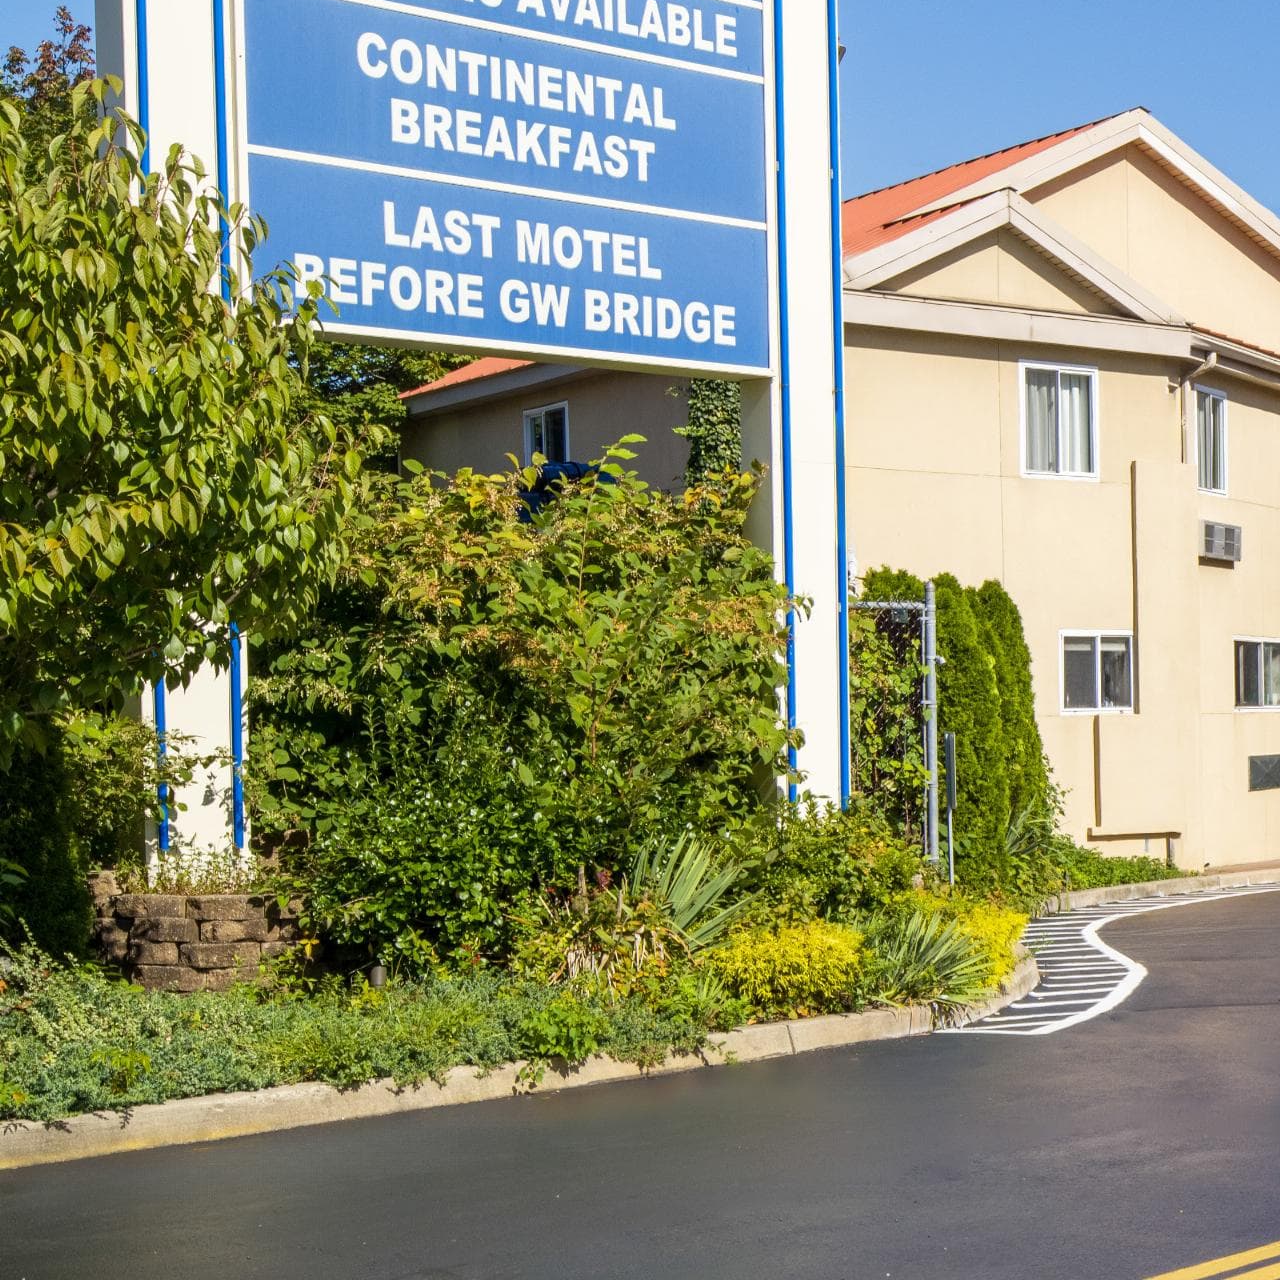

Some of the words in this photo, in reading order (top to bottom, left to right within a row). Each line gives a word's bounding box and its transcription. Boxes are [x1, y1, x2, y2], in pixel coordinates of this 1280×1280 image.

[356, 32, 677, 131] CONTINENTAL
[390, 98, 656, 183] BREAKFAST
[383, 201, 500, 259] LAST
[516, 220, 662, 280] MOTEL
[293, 253, 485, 320] BEFORE
[499, 279, 571, 328] GW
[584, 287, 737, 347] BRIDGE
